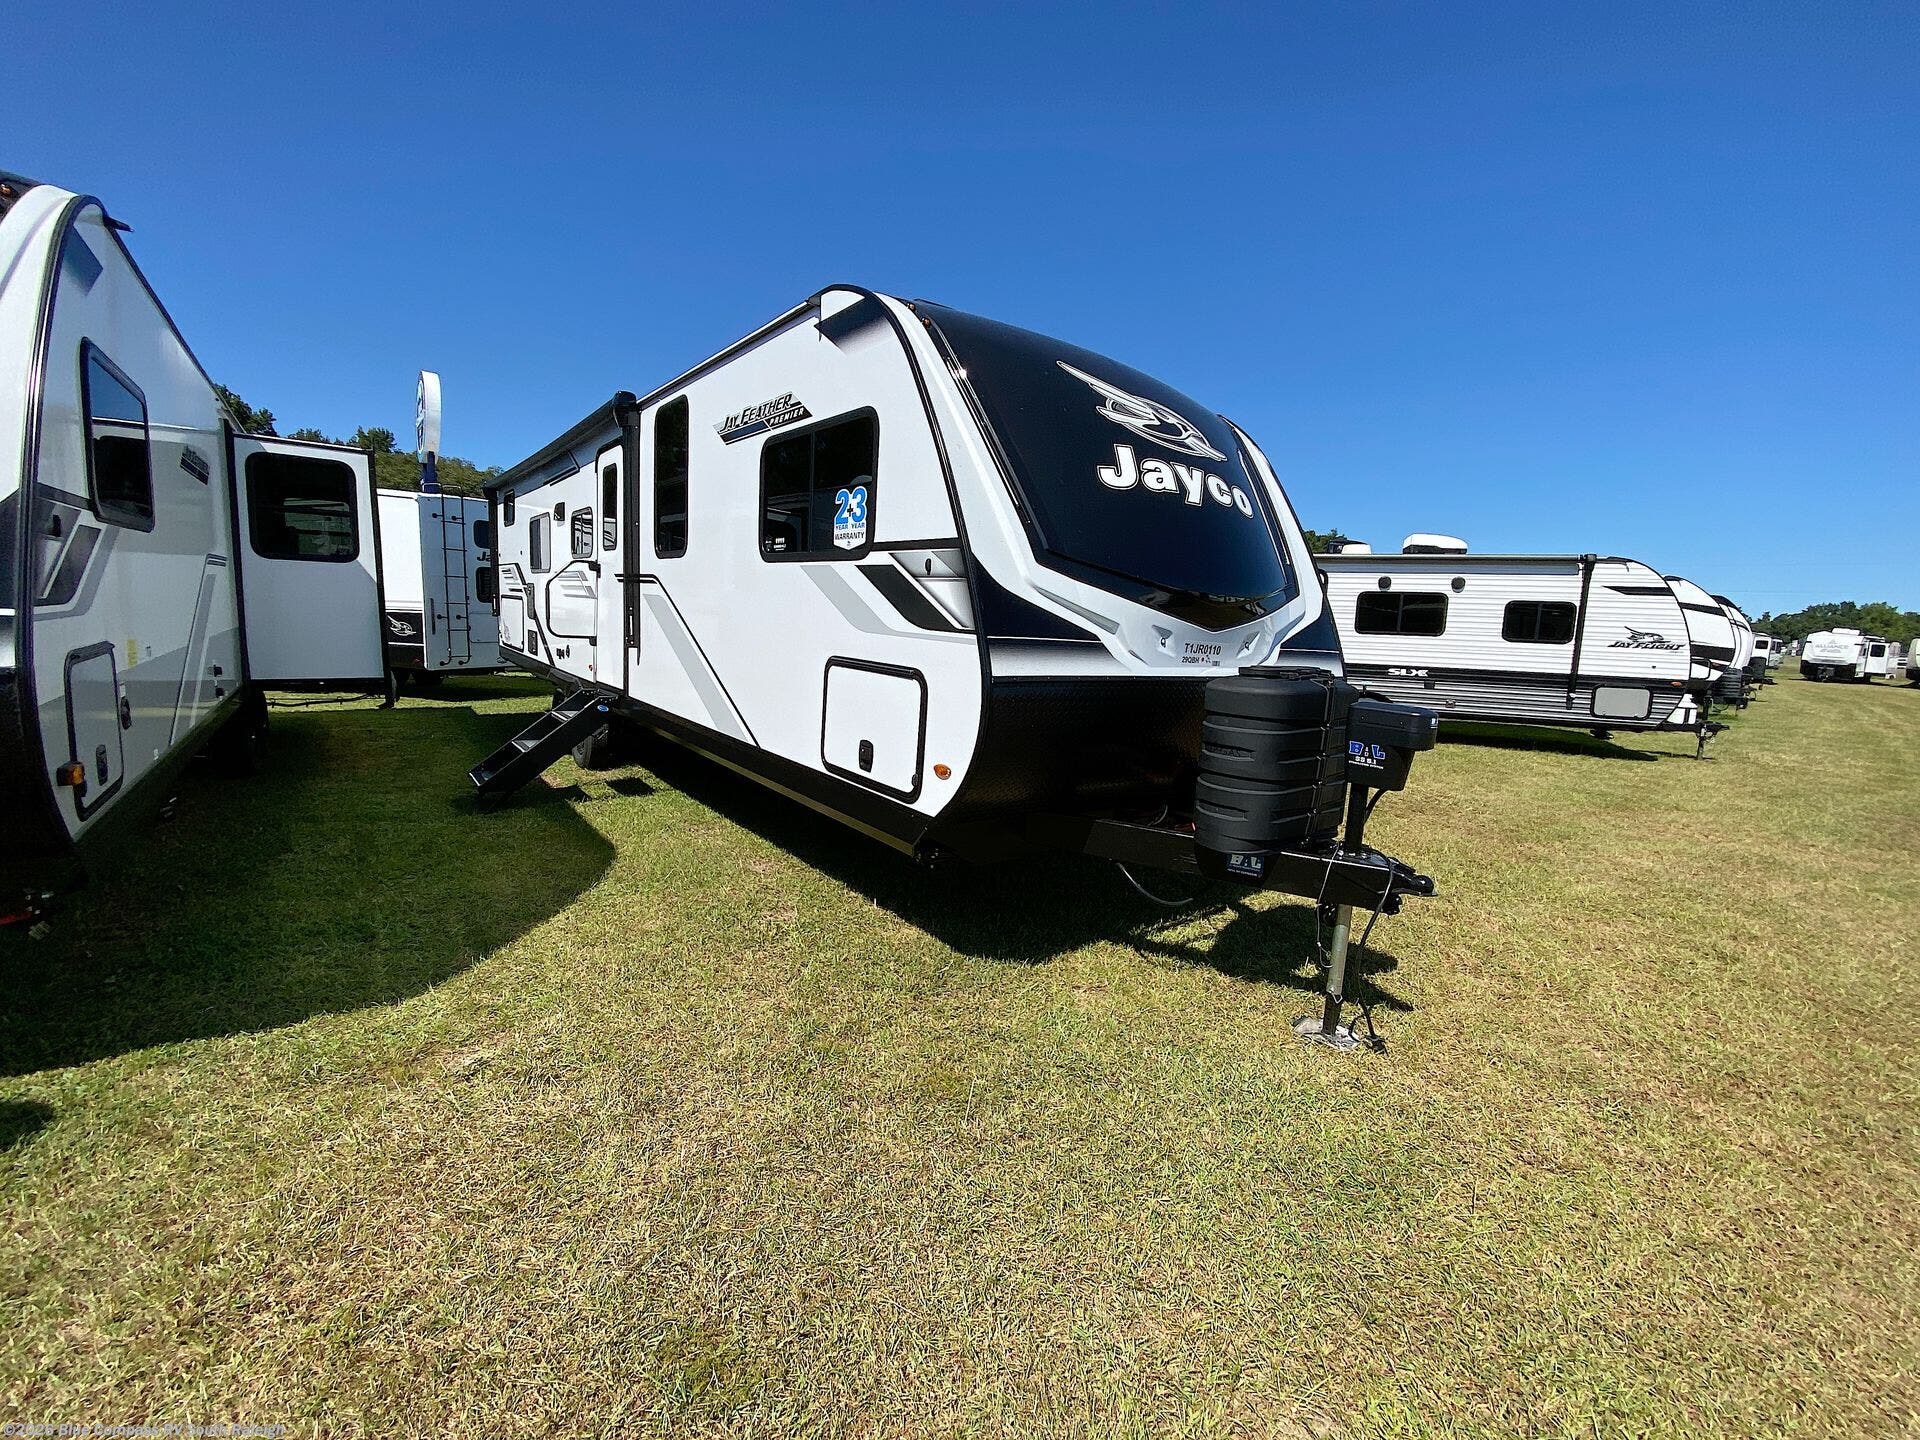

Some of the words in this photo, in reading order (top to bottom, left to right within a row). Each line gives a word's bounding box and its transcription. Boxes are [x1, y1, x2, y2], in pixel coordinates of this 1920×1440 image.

[720, 413, 740, 433] JAY
[740, 393, 793, 425] FEATHER
[768, 407, 805, 426] PREMIER
[1097, 443, 1254, 518] Jayco
[834, 531, 865, 540] WARRANTY
[1184, 642, 1222, 656] T1JR0110
[1633, 642, 1686, 651] FLIGHT
[1387, 668, 1429, 677] SLX
